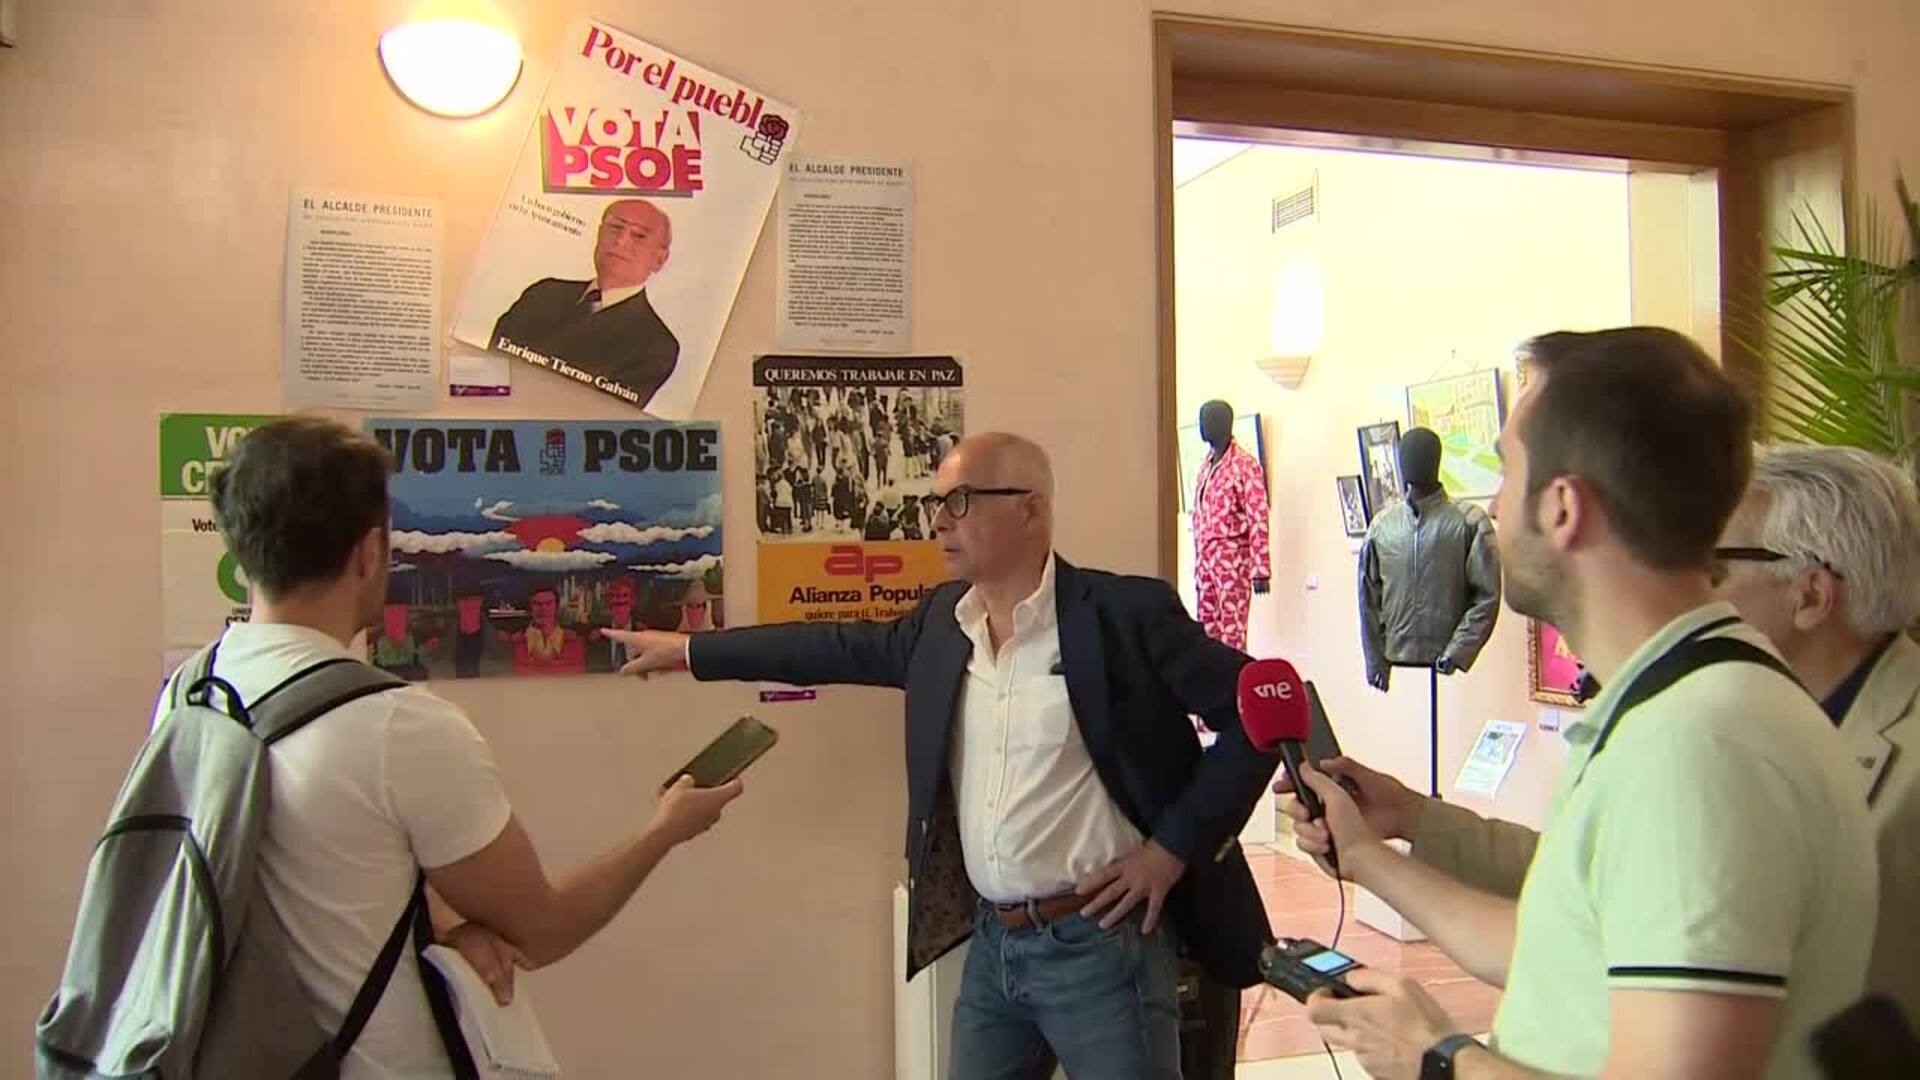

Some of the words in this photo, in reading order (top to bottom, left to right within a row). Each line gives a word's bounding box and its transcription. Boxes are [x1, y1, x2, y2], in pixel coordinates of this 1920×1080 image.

[582, 26, 642, 75] Por
[643, 59, 676, 91] el
[549, 106, 700, 149] VOTA
[549, 145, 703, 191] PSOE
[788, 163, 800, 173] EL
[805, 163, 844, 175] ALCALDE
[850, 165, 904, 178] PRESIDENTE
[303, 199, 315, 209] EL
[322, 201, 367, 213] ALCALDE
[373, 204, 433, 219] PRESIDENTE
[497, 336, 550, 367] Enrique
[550, 355, 593, 384] Tierno
[594, 376, 640, 404] Galván
[764, 368, 837, 382] QUEREMOS
[841, 369, 905, 382] TRABAJAR
[909, 369, 925, 382] EN
[931, 370, 956, 382] PAZ
[374, 428, 521, 474] VOTA
[584, 428, 718, 473] PSOE
[824, 545, 903, 583] ap
[789, 586, 862, 604] Alianza
